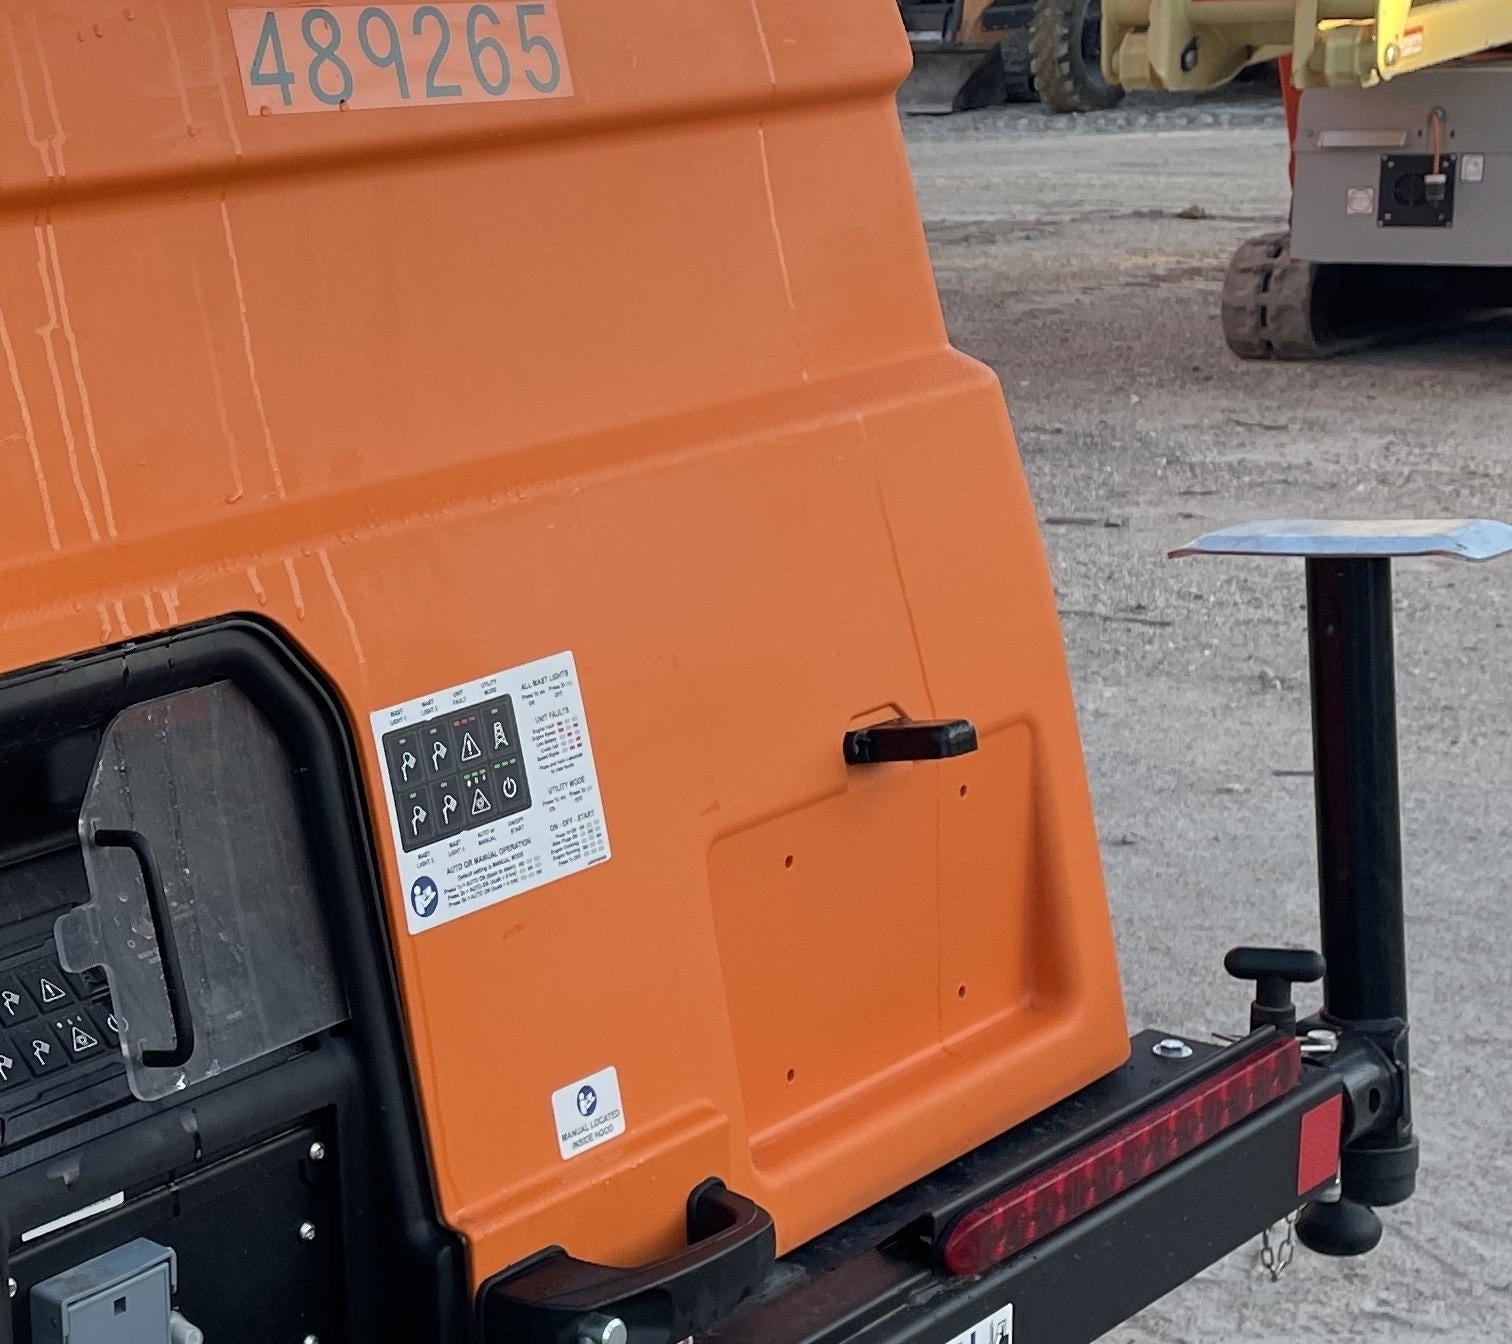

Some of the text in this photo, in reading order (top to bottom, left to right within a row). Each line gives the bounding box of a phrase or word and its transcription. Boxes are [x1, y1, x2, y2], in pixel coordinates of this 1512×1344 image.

[250, 4, 560, 106] 489265
[446, 863, 463, 874] AUTO
[473, 850, 498, 863] MANUAL
[497, 838, 531, 854] OPERATION
[562, 1109, 620, 1141] MANUAL LOCATED
[572, 1133, 594, 1149] INSIDE
